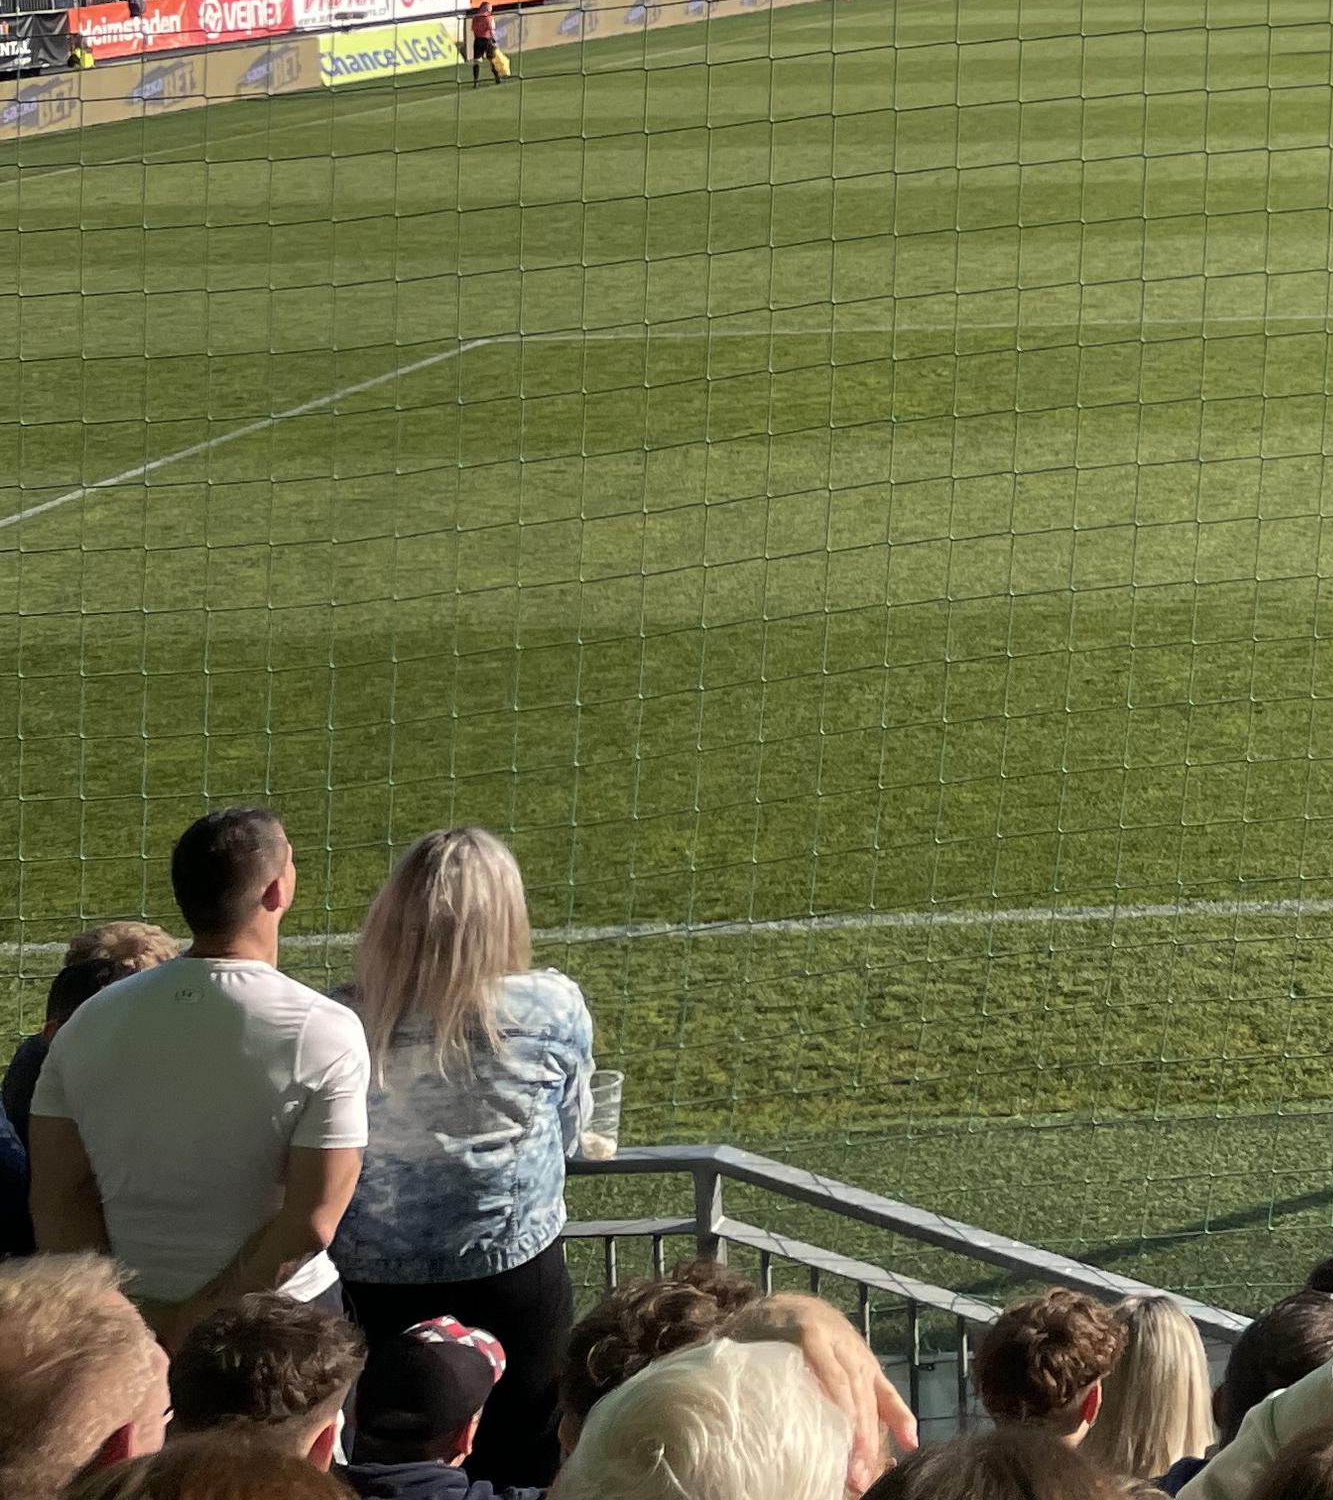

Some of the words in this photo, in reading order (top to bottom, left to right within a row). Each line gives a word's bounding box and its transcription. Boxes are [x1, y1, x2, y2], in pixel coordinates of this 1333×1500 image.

[78, 8, 181, 47] Heimstaden
[320, 46, 399, 78] Chance
[403, 33, 444, 66] LIGA
